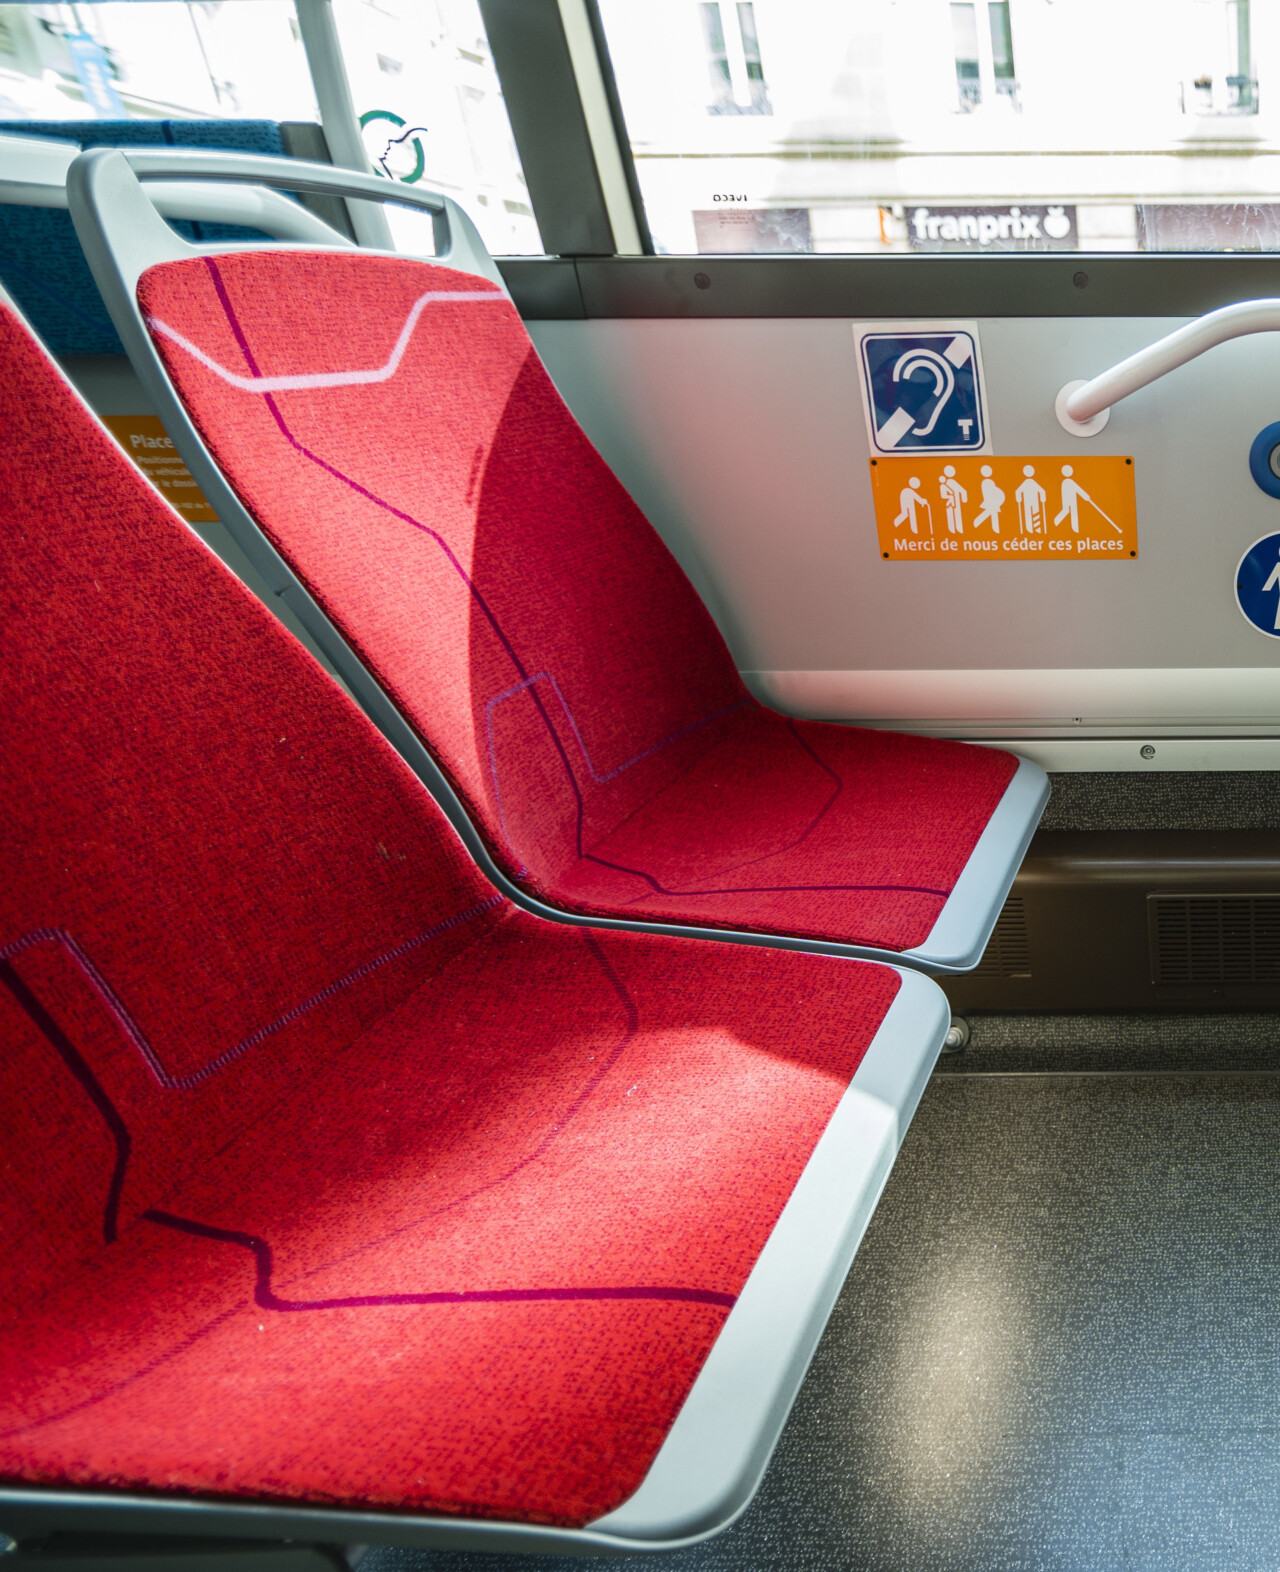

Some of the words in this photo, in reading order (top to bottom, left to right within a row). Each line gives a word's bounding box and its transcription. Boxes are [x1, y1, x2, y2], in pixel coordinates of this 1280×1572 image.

[912, 207, 1042, 245] franprix
[893, 538, 935, 551] Merci
[940, 537, 959, 551] de
[963, 540, 998, 551] nous
[1002, 537, 1044, 551] céder
[1049, 540, 1072, 551] ces
[1077, 537, 1124, 553] places
